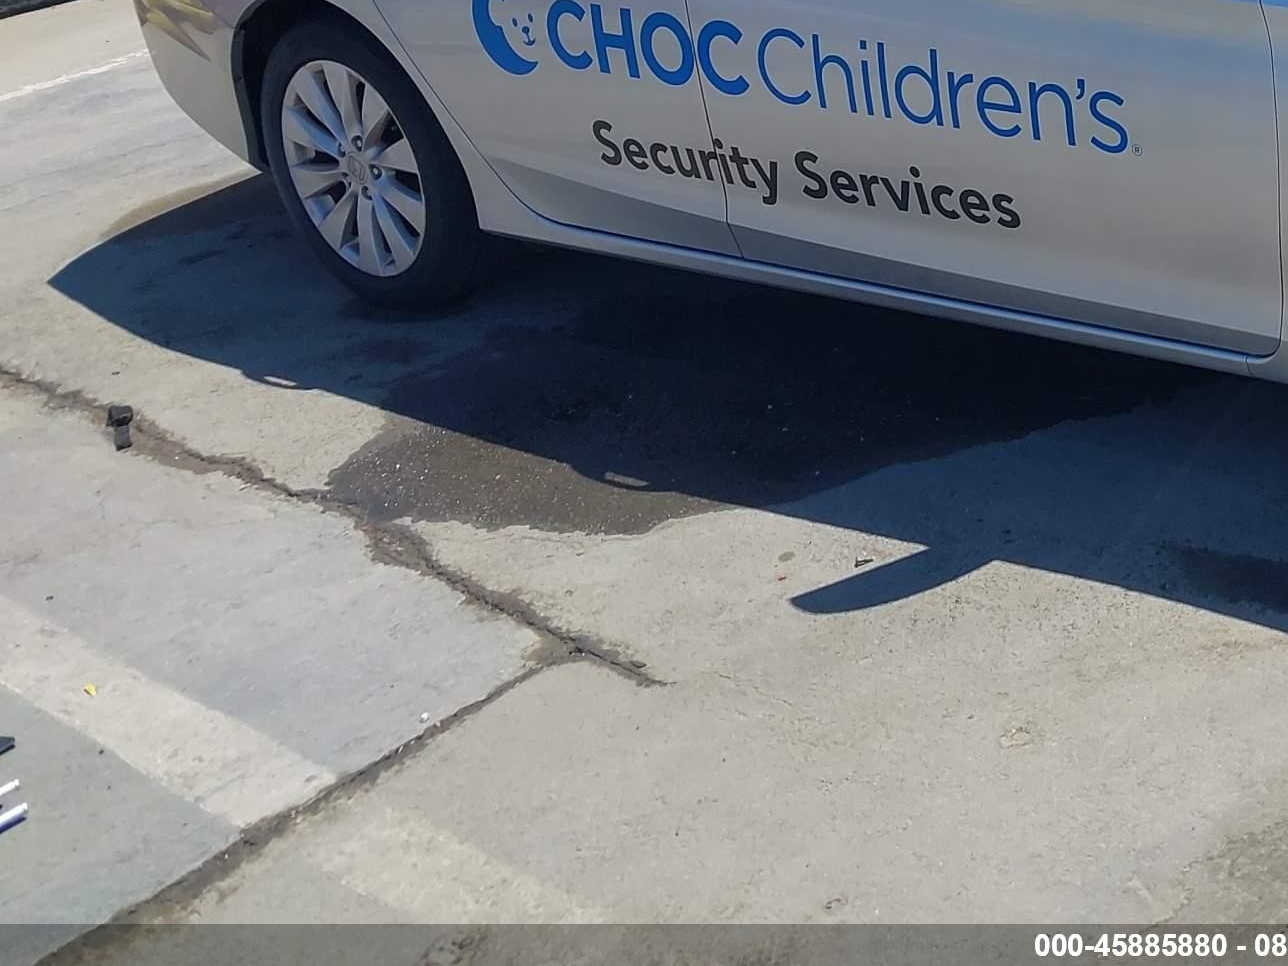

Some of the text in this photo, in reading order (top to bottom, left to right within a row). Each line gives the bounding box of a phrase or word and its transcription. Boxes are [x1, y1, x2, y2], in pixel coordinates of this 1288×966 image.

[757, 28, 1129, 154] Children's
[593, 120, 1022, 228] Security Services
